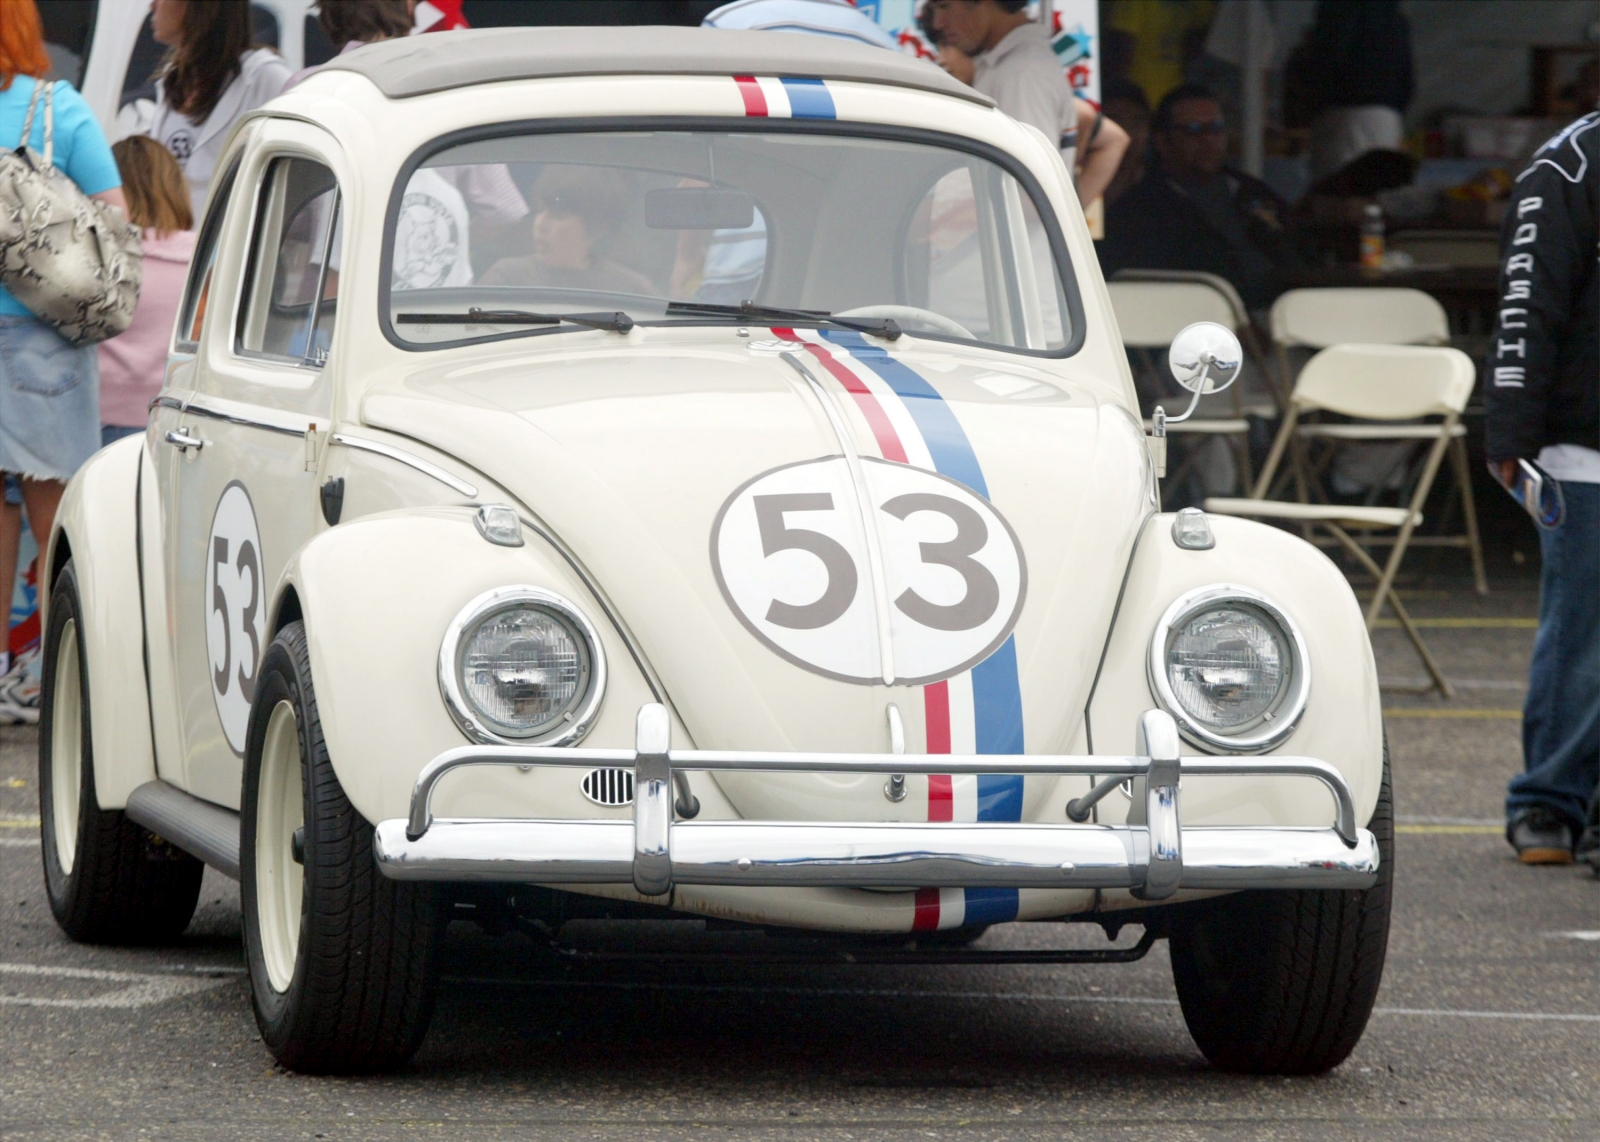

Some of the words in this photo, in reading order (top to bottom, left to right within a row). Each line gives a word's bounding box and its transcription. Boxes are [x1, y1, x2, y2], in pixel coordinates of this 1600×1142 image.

[1494, 196, 1543, 388] PORSCHE
[213, 535, 260, 704] 53
[753, 492, 1000, 632] 53
